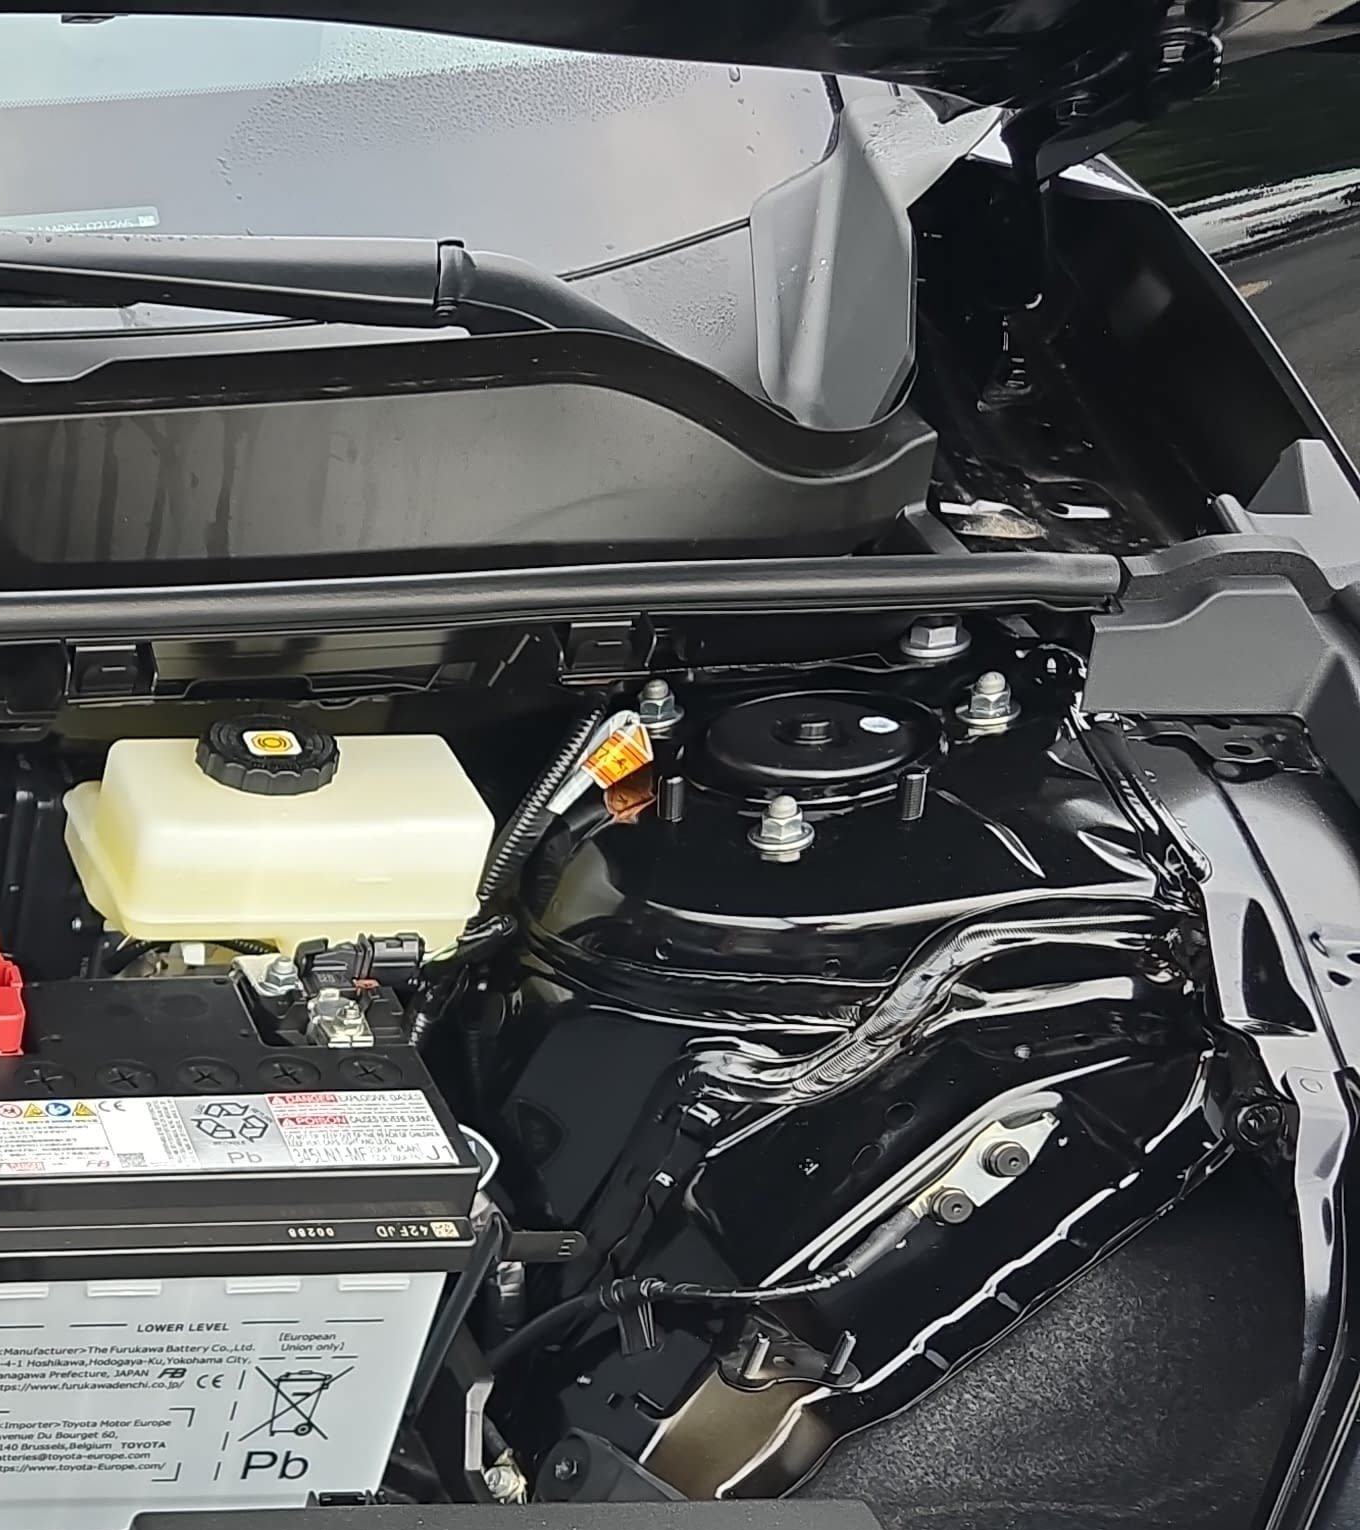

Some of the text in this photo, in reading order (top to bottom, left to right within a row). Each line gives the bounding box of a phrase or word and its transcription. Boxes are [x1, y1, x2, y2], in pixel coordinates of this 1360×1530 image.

[136, 1321, 230, 1334] LOWER LEVEL
[109, 1343, 164, 1355] Furukawa
[165, 1343, 210, 1355] Battery
[280, 1342, 314, 1352] Union
[224, 1355, 252, 1367] City,
[48, 1369, 111, 1381] Prefecture,
[113, 1367, 150, 1379] JAPAN
[99, 1417, 131, 1429] Motor
[133, 1417, 172, 1430] Europe
[36, 1430, 53, 1441] Du
[55, 1430, 99, 1443] Bourget
[120, 1441, 166, 1450] TOYOTA
[239, 1450, 309, 1481] Pb
